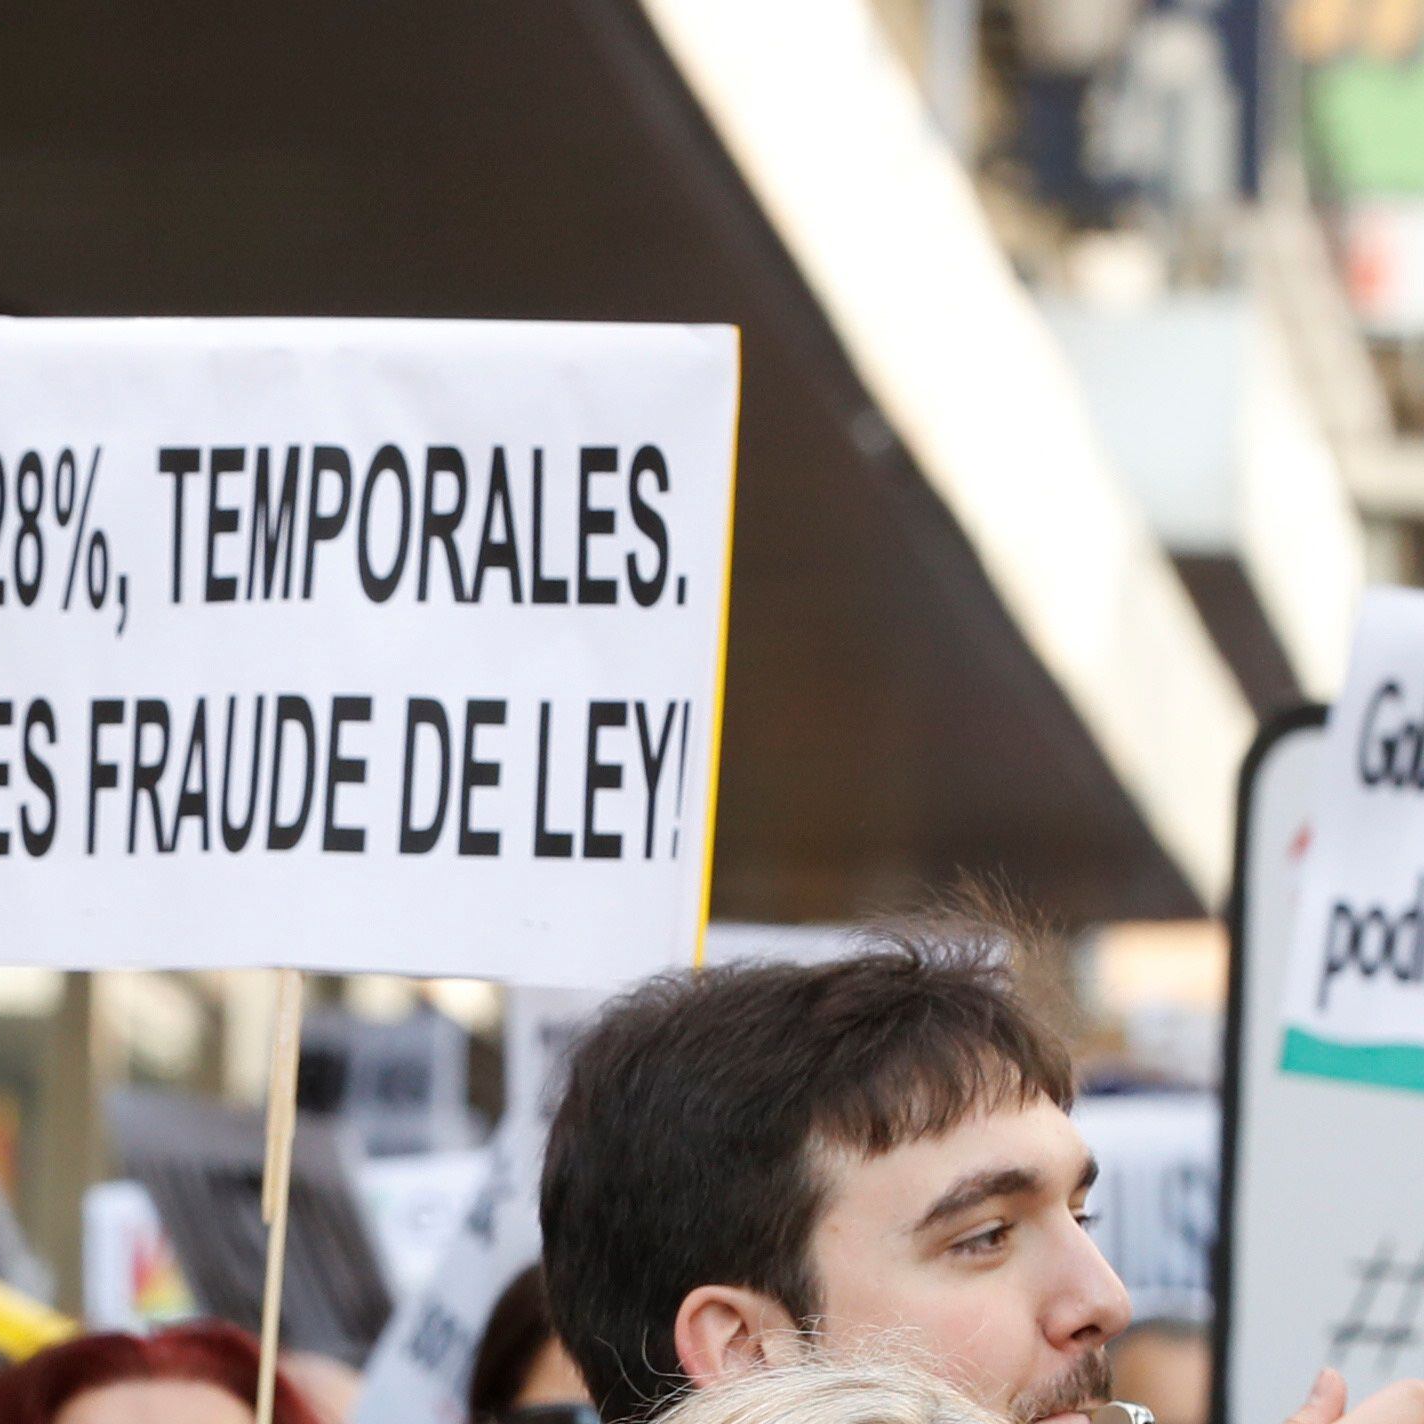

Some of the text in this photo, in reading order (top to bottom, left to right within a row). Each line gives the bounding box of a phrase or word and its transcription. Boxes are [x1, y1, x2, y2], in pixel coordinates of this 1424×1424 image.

[156, 442, 687, 608] TEMPORALES.
[84, 693, 375, 857] FRAUDE
[398, 697, 509, 856] DE
[532, 698, 693, 862] LEY!
